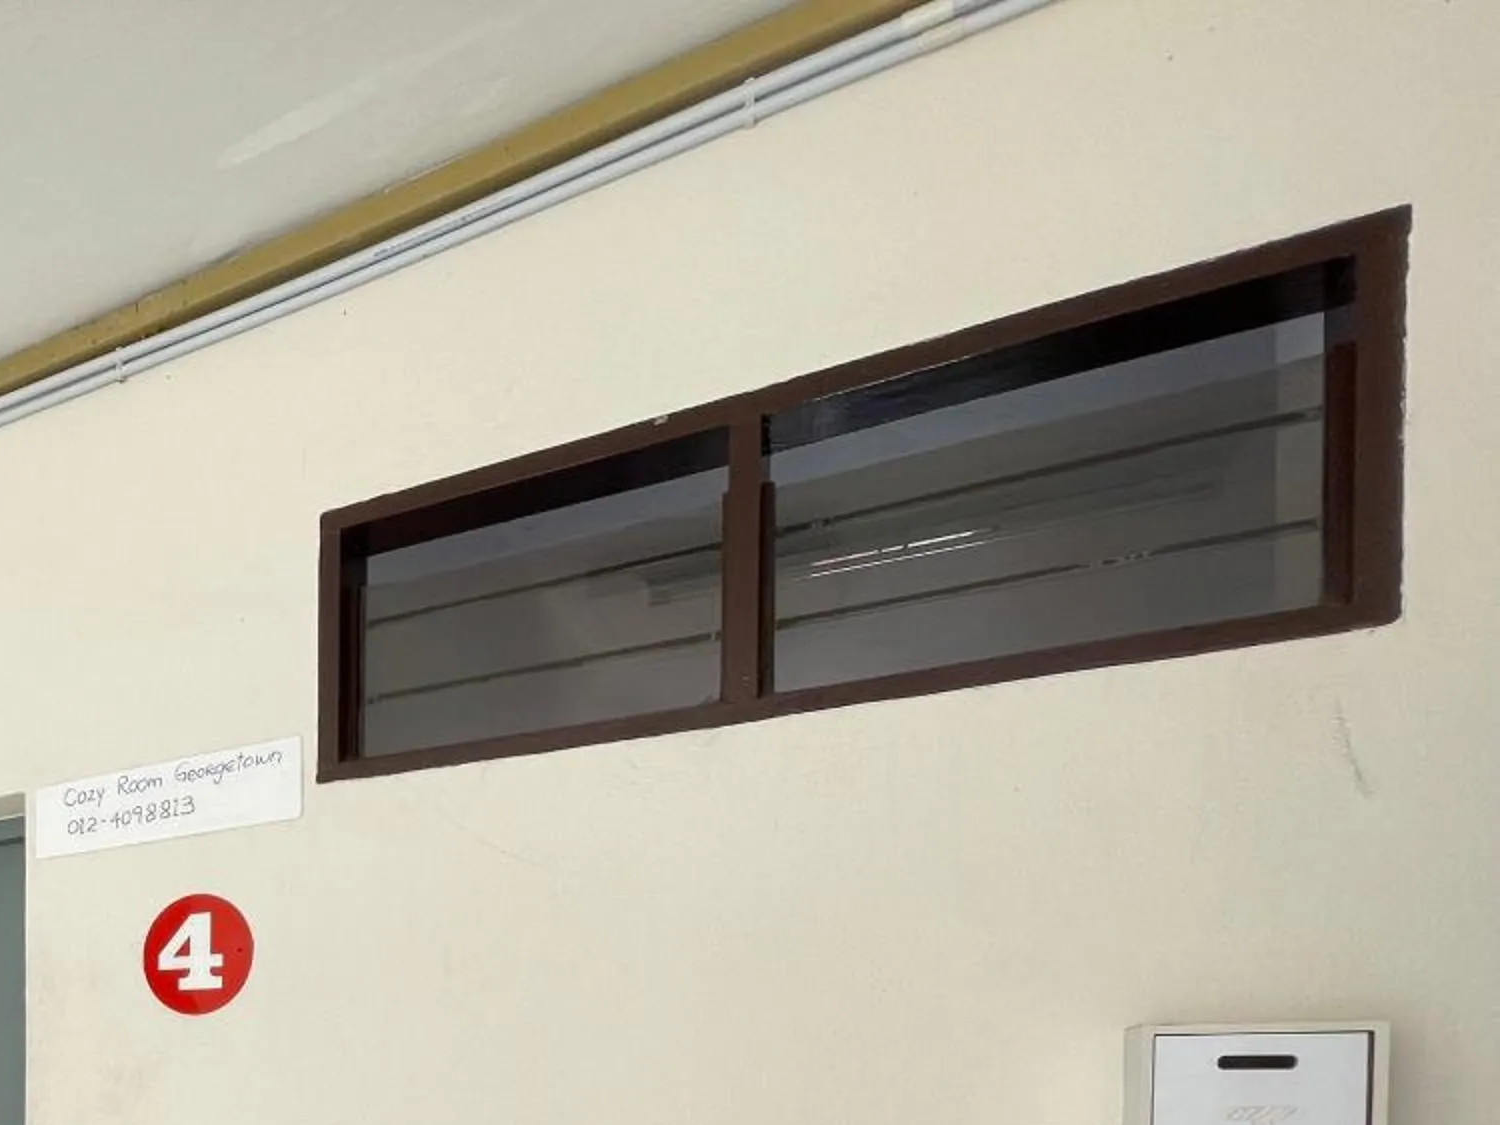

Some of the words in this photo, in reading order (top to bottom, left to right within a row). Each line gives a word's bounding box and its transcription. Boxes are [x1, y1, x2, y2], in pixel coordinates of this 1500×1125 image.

[63, 786, 106, 808] Cozy
[117, 774, 164, 796] Room
[66, 795, 197, 836] 012-4098813
[157, 911, 225, 991] 4
